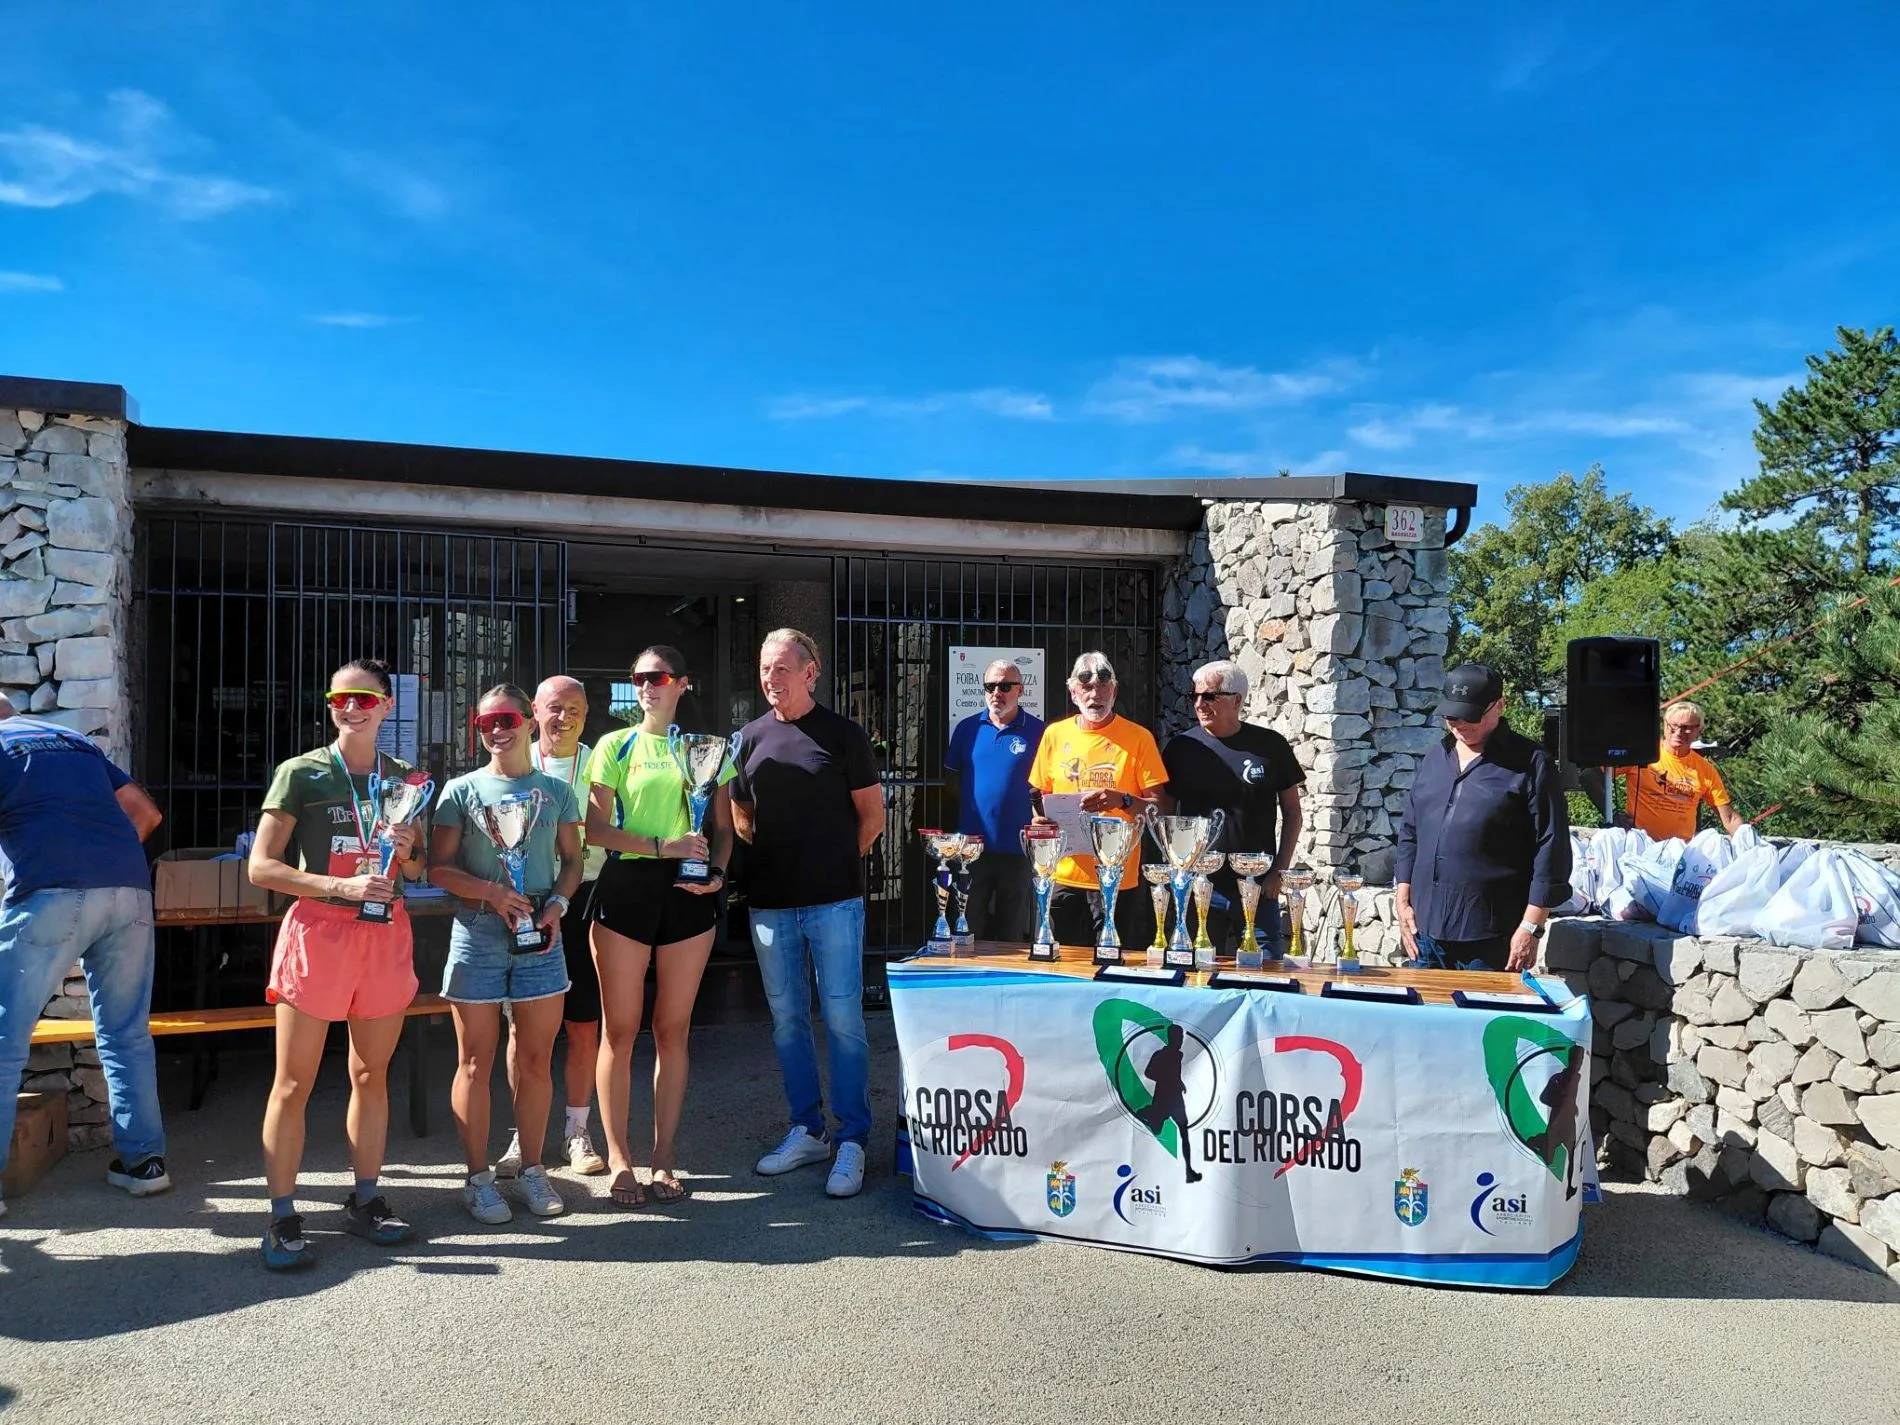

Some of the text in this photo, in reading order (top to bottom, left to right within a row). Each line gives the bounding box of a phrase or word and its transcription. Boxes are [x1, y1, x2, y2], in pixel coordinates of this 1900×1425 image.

[1391, 509, 1415, 531] 362
[956, 672, 980, 685] FOIBA
[955, 698, 978, 708] Centro
[1250, 765, 1265, 774] asi
[916, 1086, 1013, 1131] CORSA
[1236, 1090, 1346, 1143] CORSA
[931, 1122, 1028, 1158] RICORDO
[1203, 1128, 1362, 1173] DEL RICORDO
[1130, 1185, 1162, 1205] asi
[1492, 1193, 1528, 1214] asi
